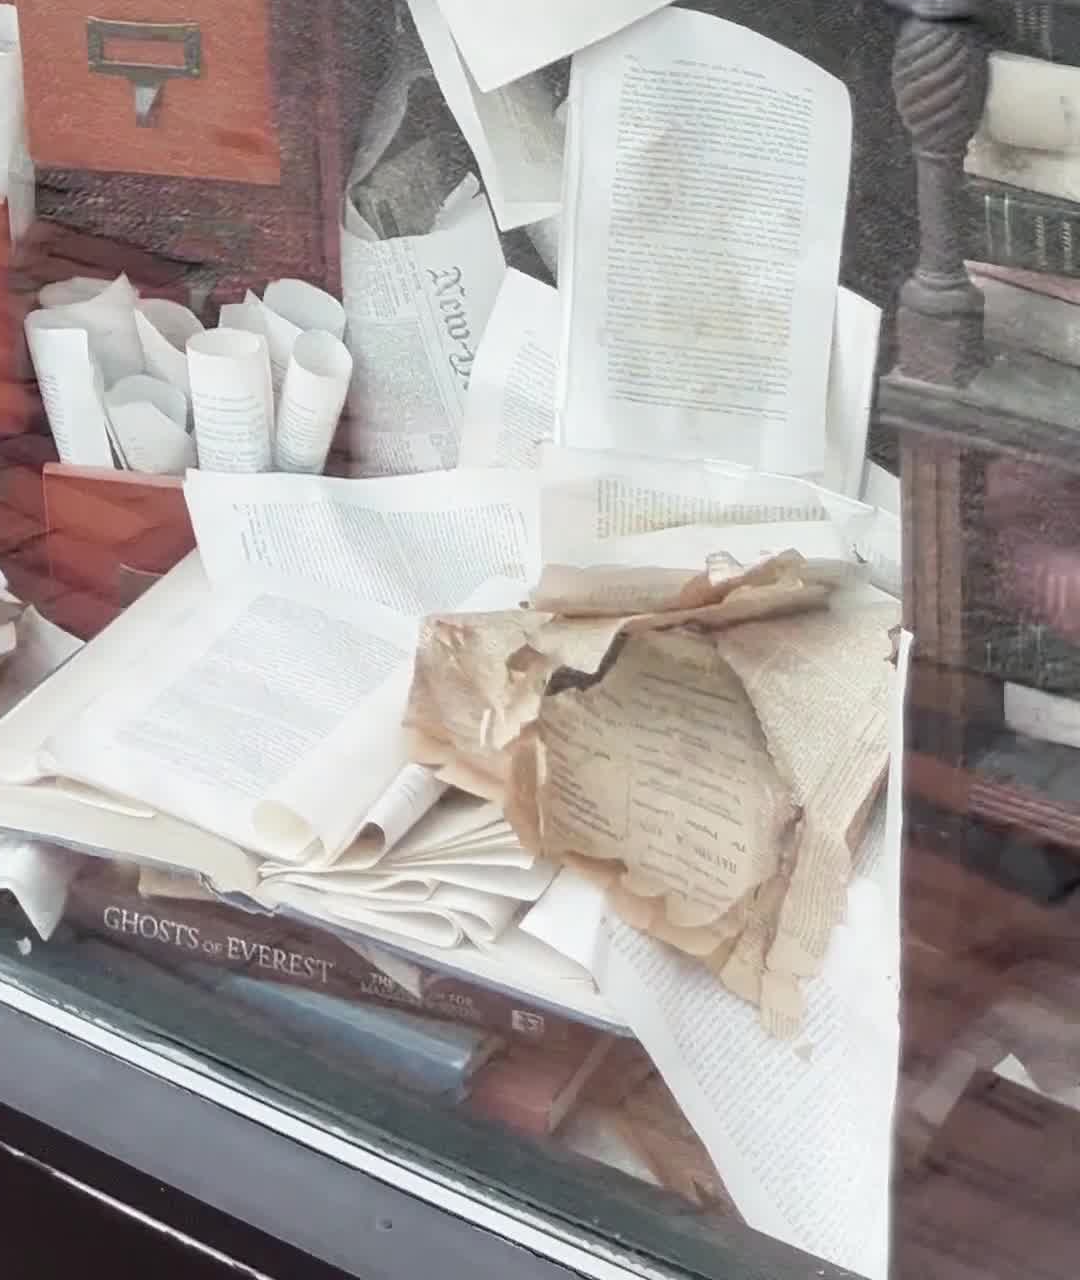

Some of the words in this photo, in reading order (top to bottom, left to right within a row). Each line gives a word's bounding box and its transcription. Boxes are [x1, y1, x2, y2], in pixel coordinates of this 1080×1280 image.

[103, 905, 201, 950] GHOSTS
[201, 939, 220, 954] OF
[226, 936, 335, 984] EVEREST
